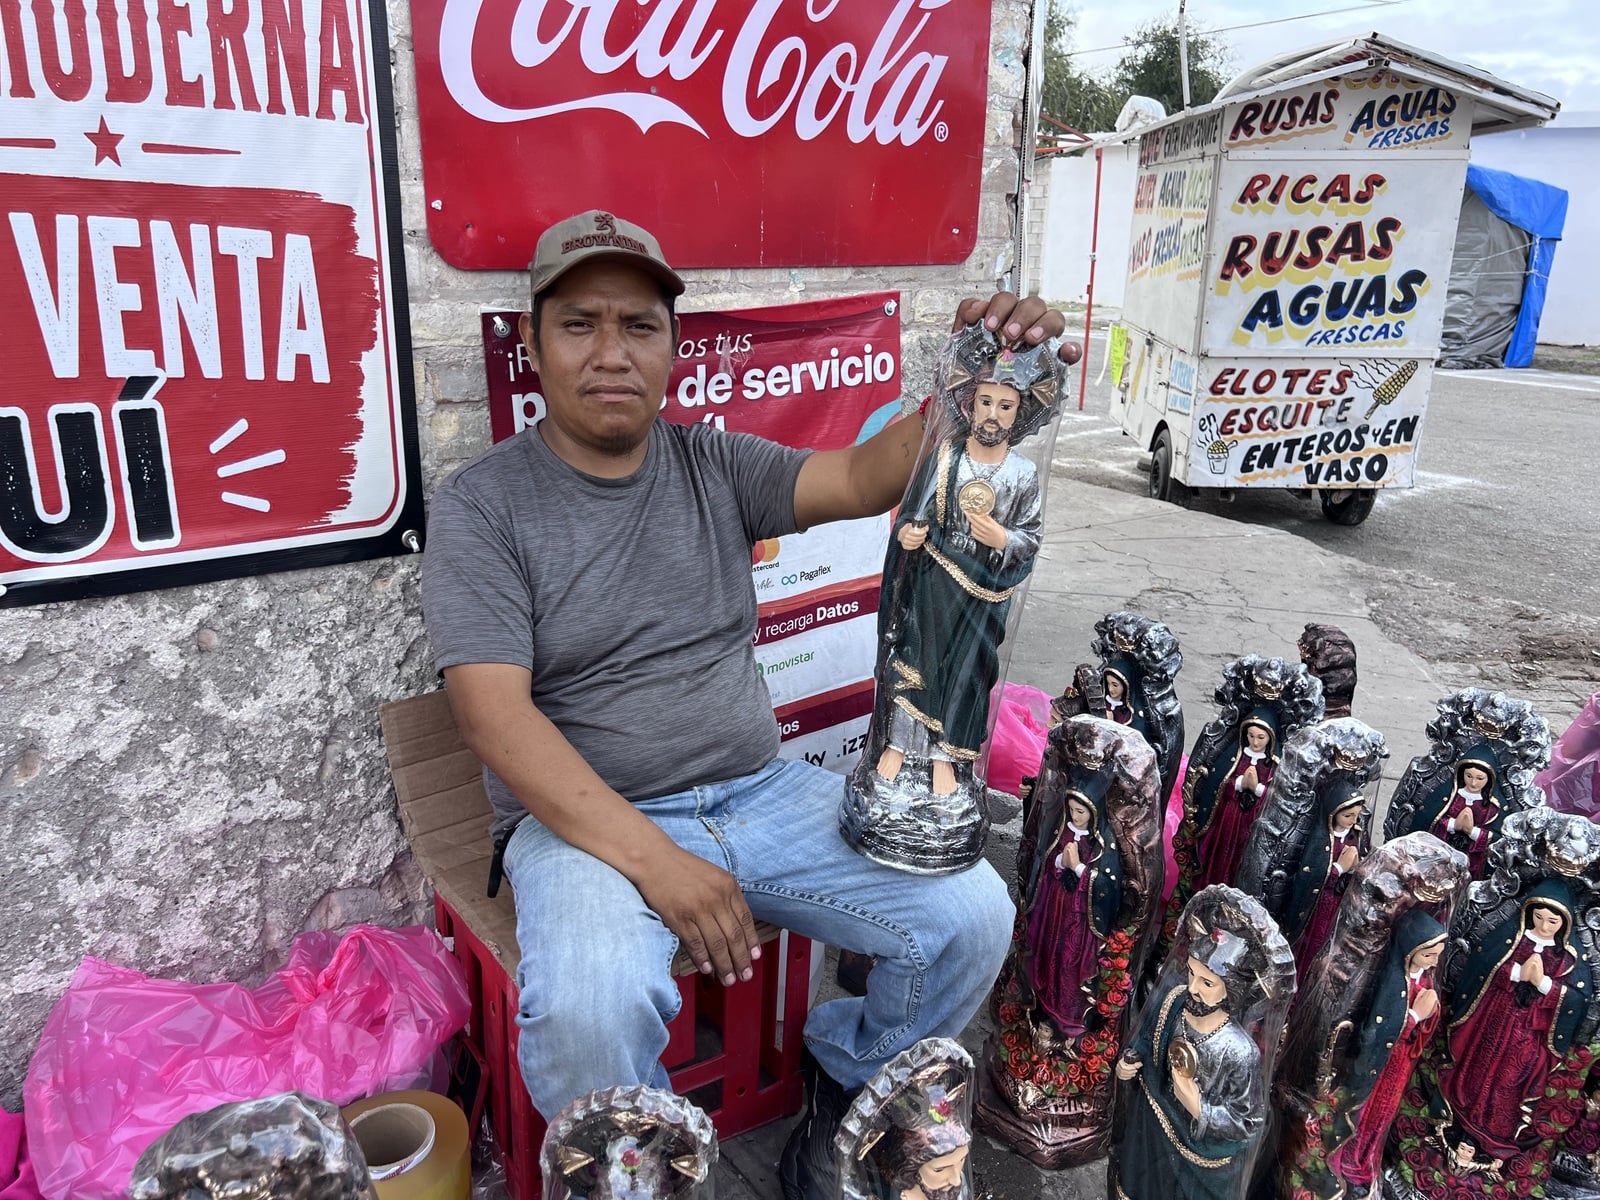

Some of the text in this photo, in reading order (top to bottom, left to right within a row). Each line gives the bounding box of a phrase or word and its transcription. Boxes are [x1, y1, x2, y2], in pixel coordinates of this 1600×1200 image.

[1229, 89, 1340, 141] RUSAS
[1350, 89, 1456, 134] AGUAS
[1368, 118, 1450, 148] FRESCAS
[1237, 173, 1387, 206] RICAS
[1219, 216, 1402, 281] RUSAS
[9, 211, 331, 383] VENTA
[1241, 269, 1428, 331] AGUAS
[715, 330, 752, 356] tus
[1305, 320, 1405, 347] FRESCAS
[677, 365, 733, 408] de
[742, 343, 895, 399] servicio
[1208, 367, 1354, 396] ELOTES
[1219, 396, 1355, 437] ESQUITE
[1240, 424, 1369, 474] ENTEROS
[1379, 415, 1420, 447] EN
[1304, 453, 1388, 485] VASO
[799, 564, 831, 582] Pagaflex
[753, 600, 859, 645] y recarga Datos
[766, 651, 815, 675] movistar
